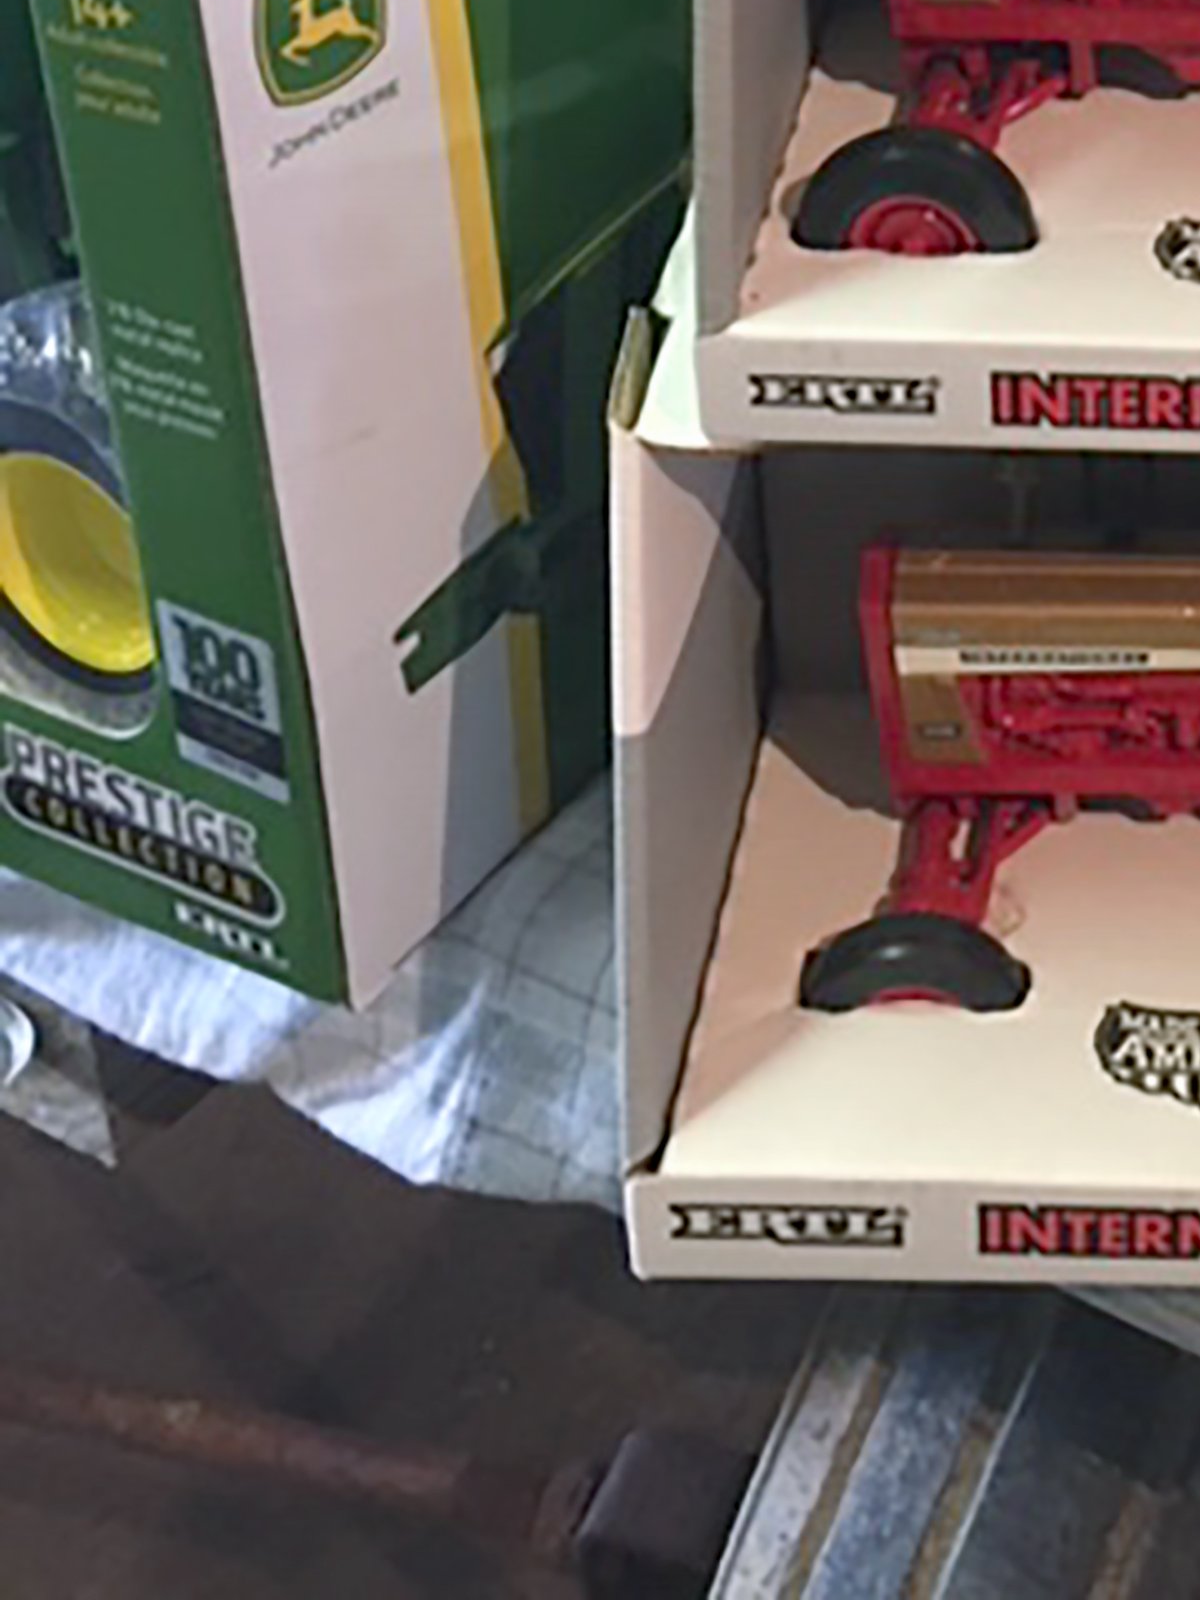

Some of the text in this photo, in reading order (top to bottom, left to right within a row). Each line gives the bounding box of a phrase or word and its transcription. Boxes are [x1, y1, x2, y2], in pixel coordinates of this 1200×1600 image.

[749, 373, 938, 415] ERTL
[8, 726, 255, 864] PRESTIGE
[24, 783, 254, 906] COLLECTION
[669, 1203, 908, 1247] ERTL
